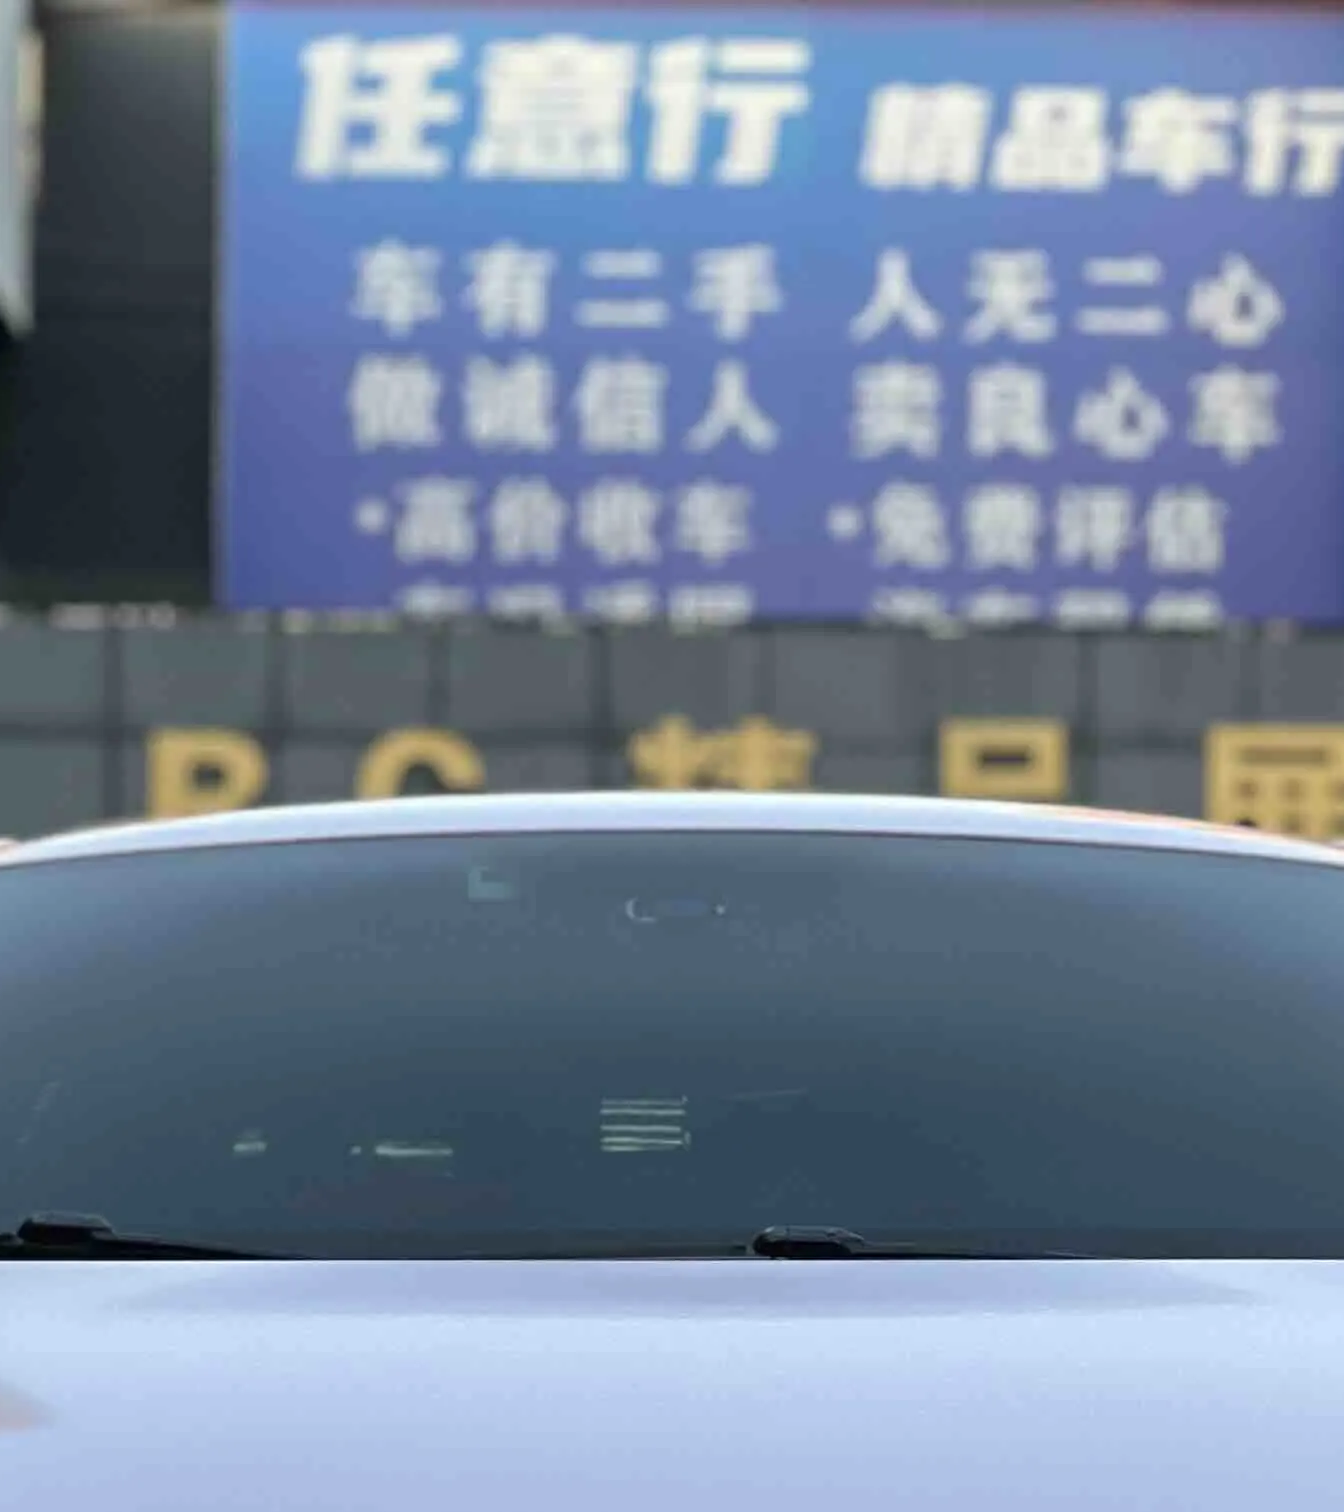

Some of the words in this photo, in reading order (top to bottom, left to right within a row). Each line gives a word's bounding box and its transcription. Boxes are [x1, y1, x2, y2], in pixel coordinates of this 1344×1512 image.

[299, 34, 809, 183] 任意行
[355, 242, 781, 340] 车有二手
[852, 249, 1283, 346] 人无二心
[350, 356, 776, 451] 做诚信人
[855, 360, 1277, 460] 卖良心车
